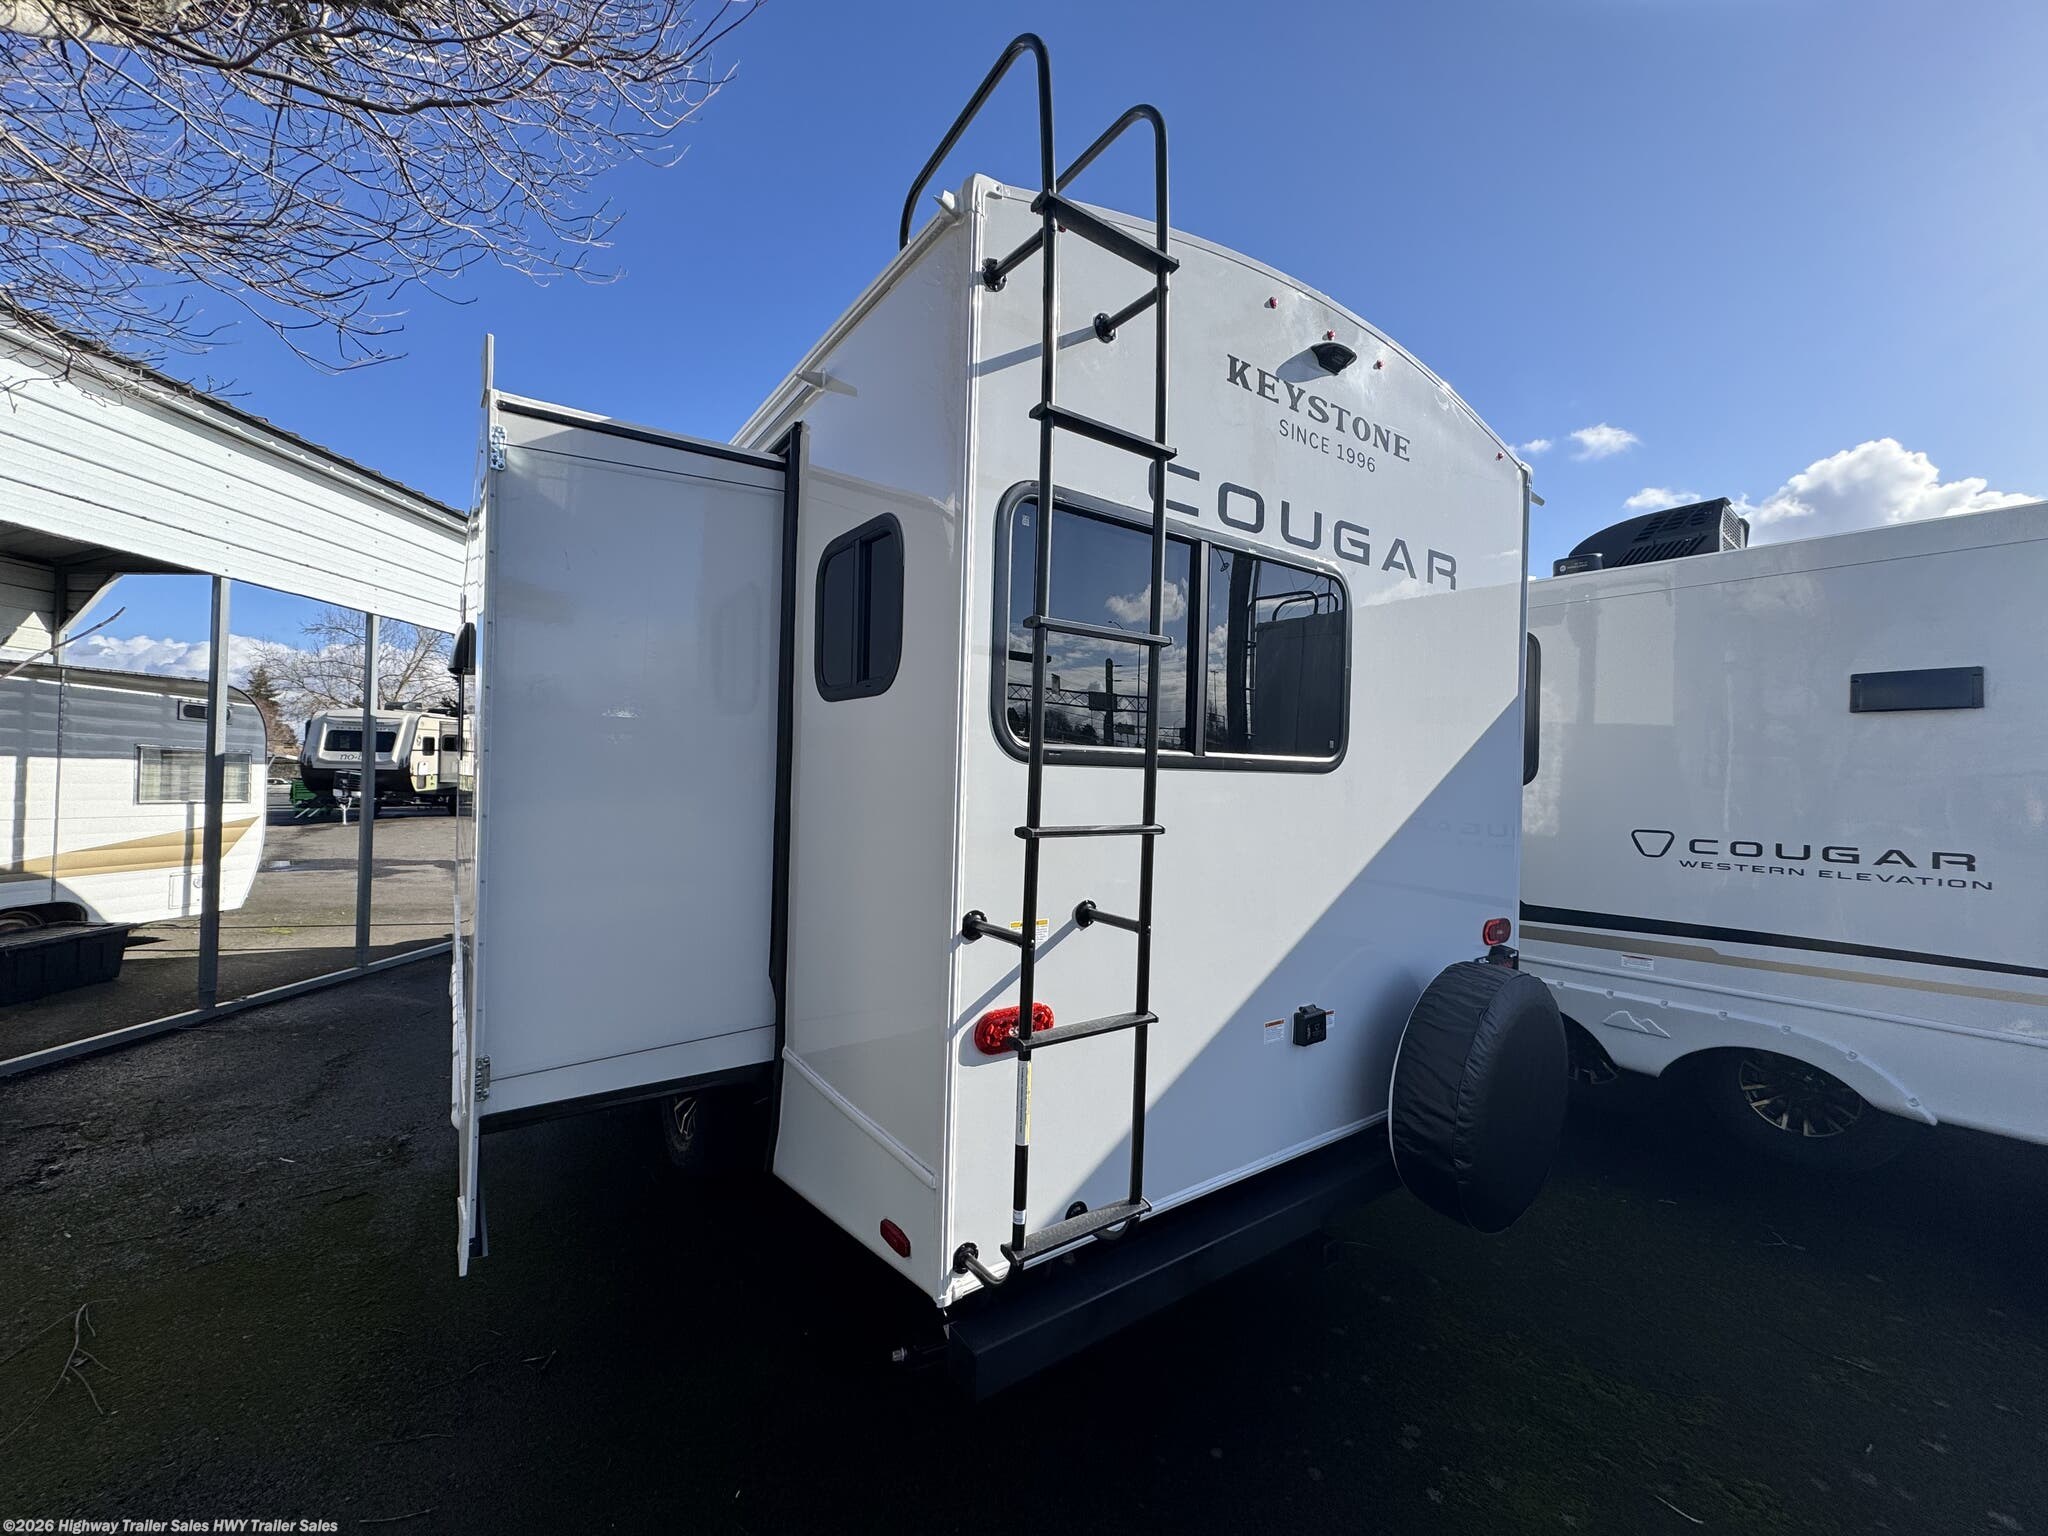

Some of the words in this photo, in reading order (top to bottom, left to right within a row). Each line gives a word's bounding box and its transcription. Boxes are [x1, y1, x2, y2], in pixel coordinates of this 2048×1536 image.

[1227, 354, 1411, 462] KEYSTONE
[1279, 419, 1330, 454] SINCE
[1336, 444, 1376, 473] 1996
[1148, 460, 1457, 591] COUGAR
[1679, 859, 1805, 877] WESTERN
[1818, 869, 1993, 890] ELEVATION
[1688, 838, 1976, 872] COUGAR
